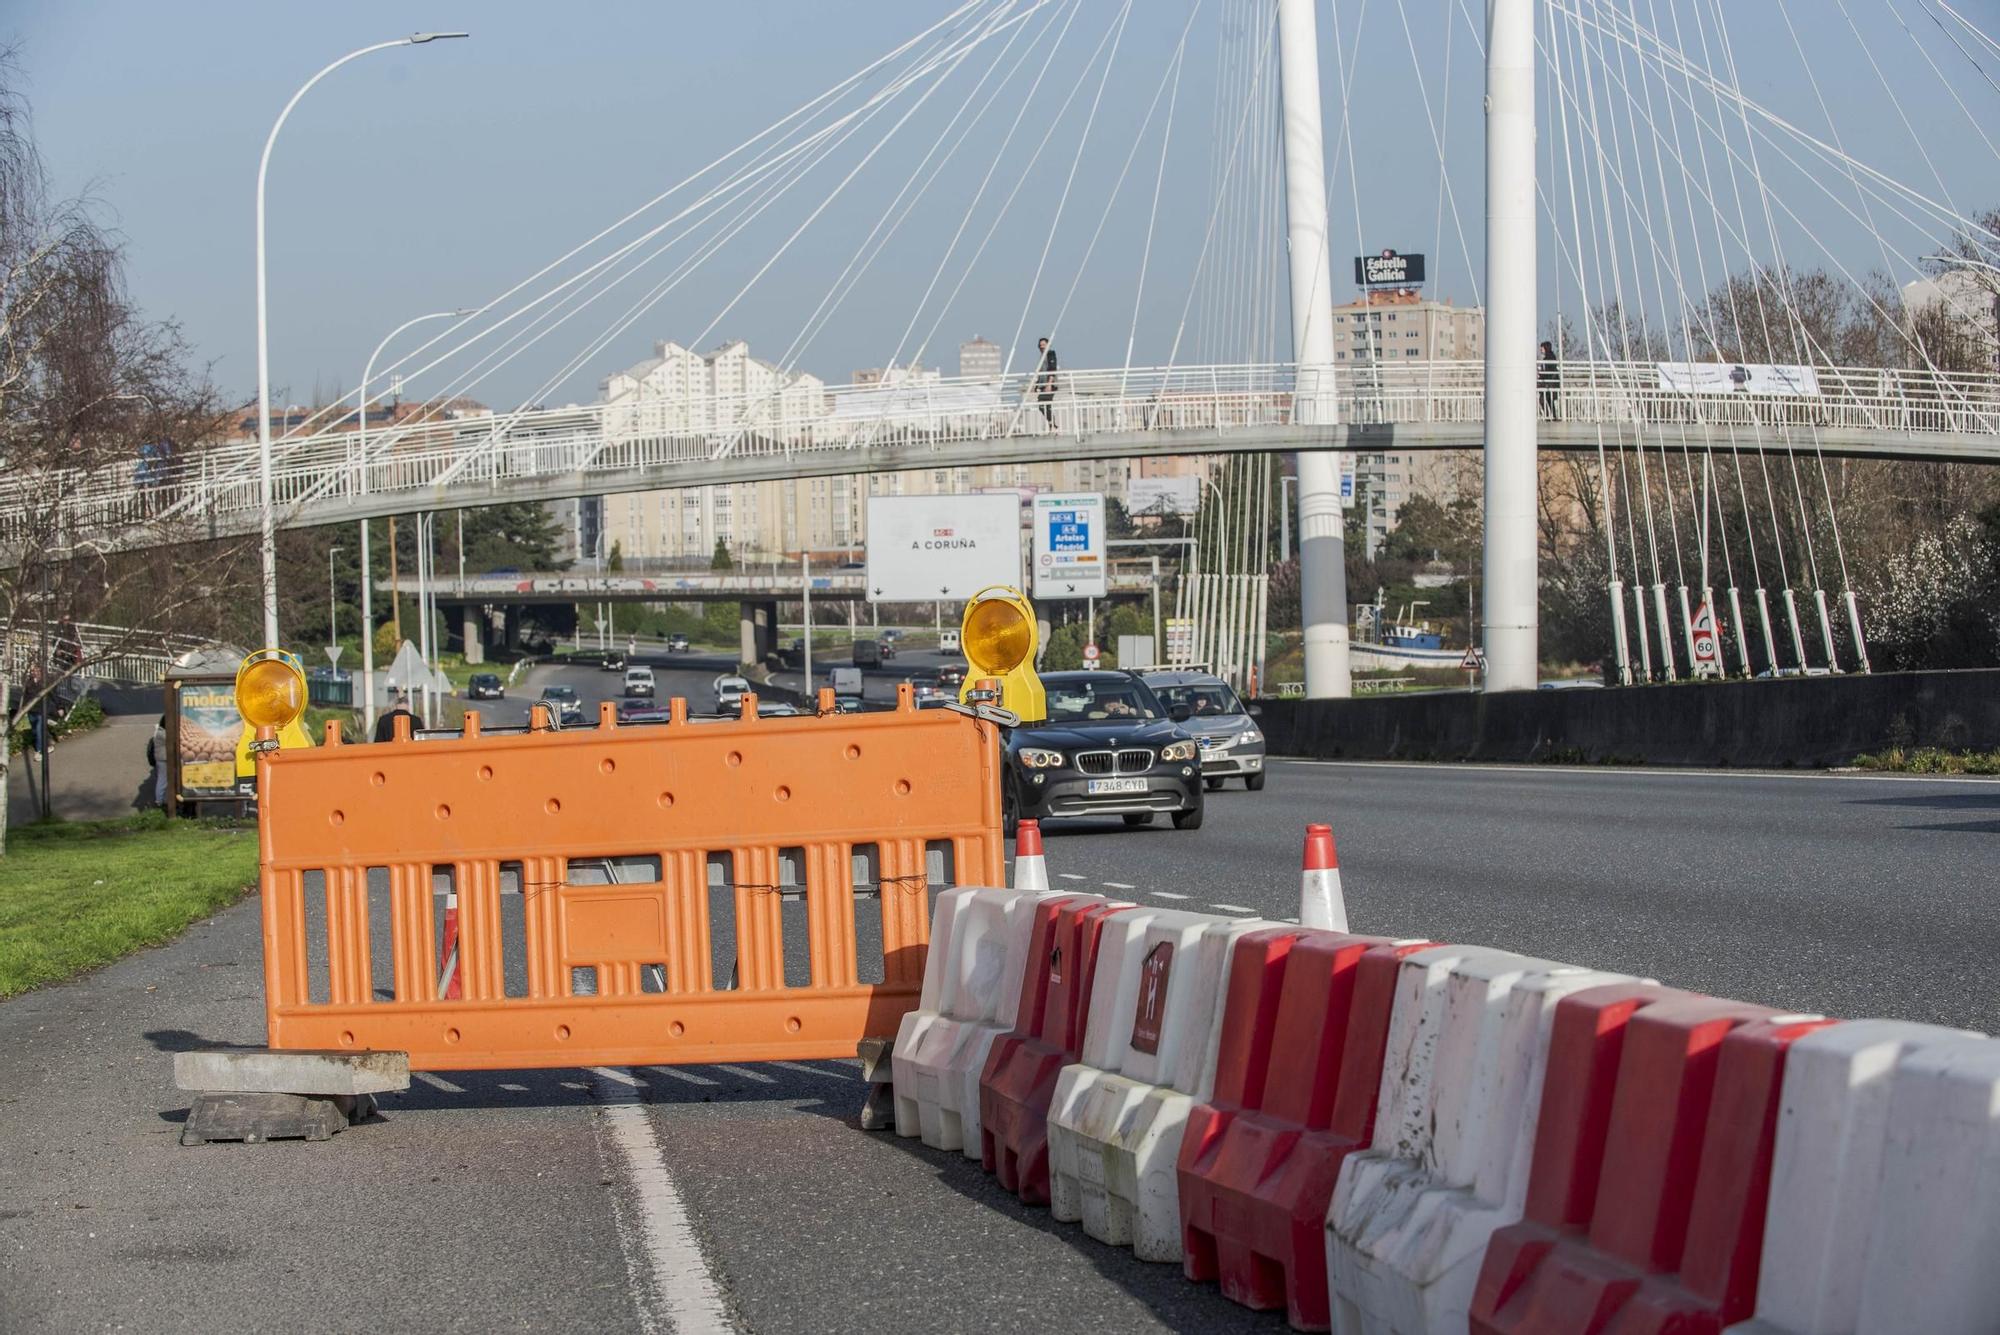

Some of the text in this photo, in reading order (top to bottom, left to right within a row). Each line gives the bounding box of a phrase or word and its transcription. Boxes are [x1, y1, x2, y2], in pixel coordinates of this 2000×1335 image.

[1366, 257, 1407, 270] Estrella
[1368, 268, 1406, 281] Galicia
[1055, 534, 1086, 542] Arteixo
[912, 538, 976, 550] A CORUÑA
[1055, 543, 1086, 551] Madrid
[1698, 643, 1712, 652] 60
